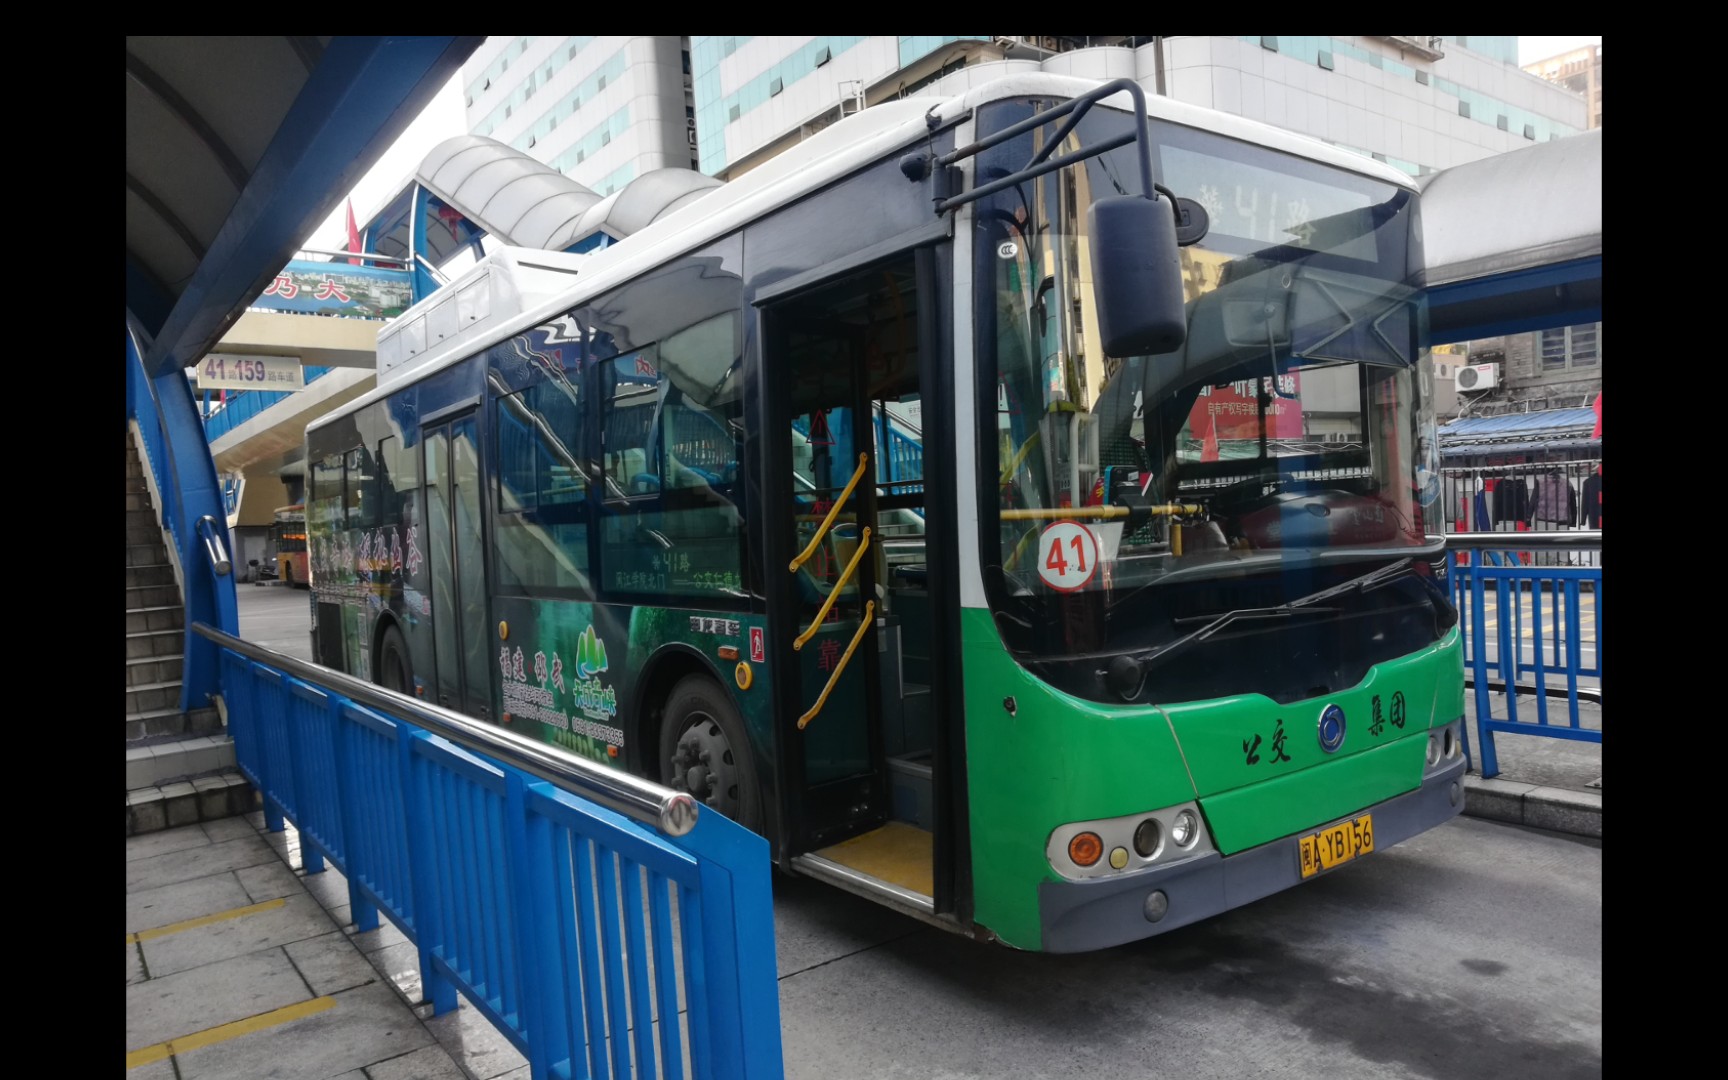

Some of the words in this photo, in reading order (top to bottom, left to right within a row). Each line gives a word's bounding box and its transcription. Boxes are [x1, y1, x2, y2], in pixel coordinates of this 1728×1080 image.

[1046, 534, 1087, 577] 41
[1242, 719, 1291, 766] 公交
[1368, 690, 1406, 737] 集团
